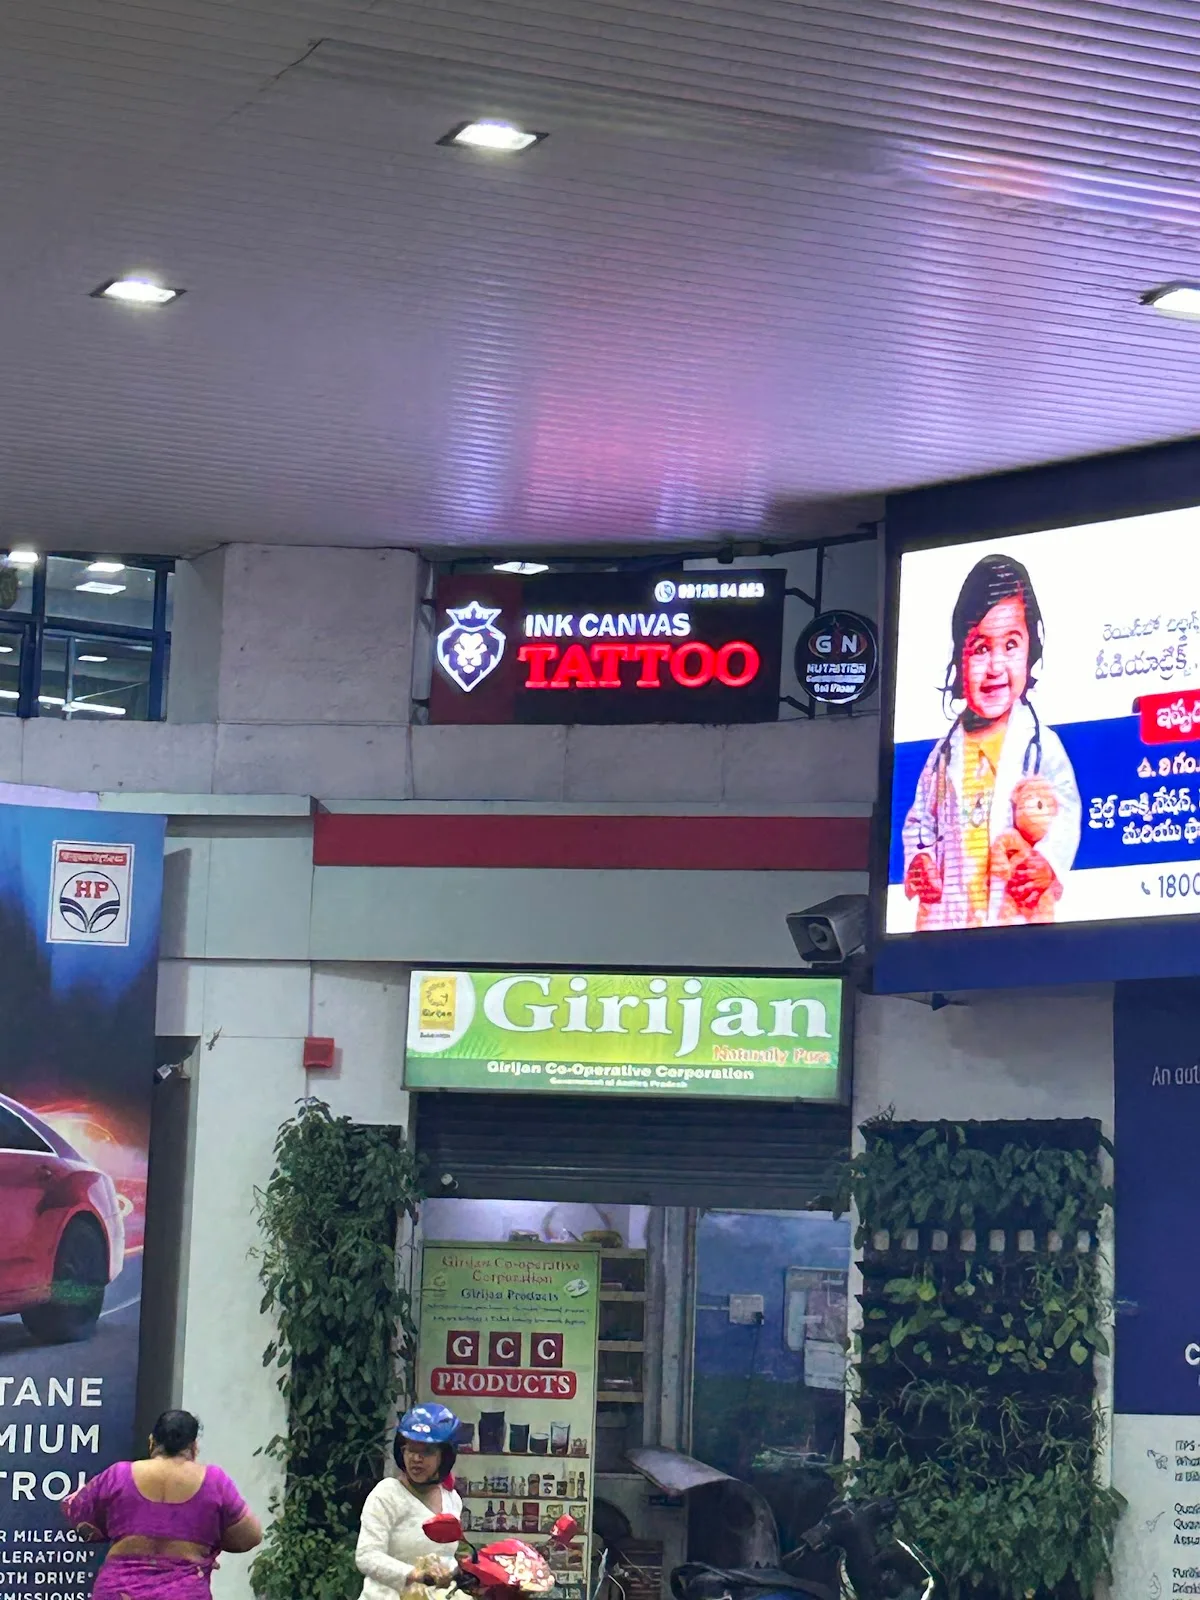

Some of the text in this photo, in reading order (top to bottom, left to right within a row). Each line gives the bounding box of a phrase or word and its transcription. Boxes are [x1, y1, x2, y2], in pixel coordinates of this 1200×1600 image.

[525, 613, 692, 638] INK CANVAS
[516, 641, 761, 688] TATTOO
[75, 880, 109, 899] HP
[483, 975, 833, 1057] Girijan
[486, 1060, 542, 1076] Girijan
[655, 1065, 755, 1080] Corporation
[1152, 1065, 1171, 1086] An
[437, 1371, 570, 1394] PRODUCTS
[13, 1529, 85, 1543] MILEAG
